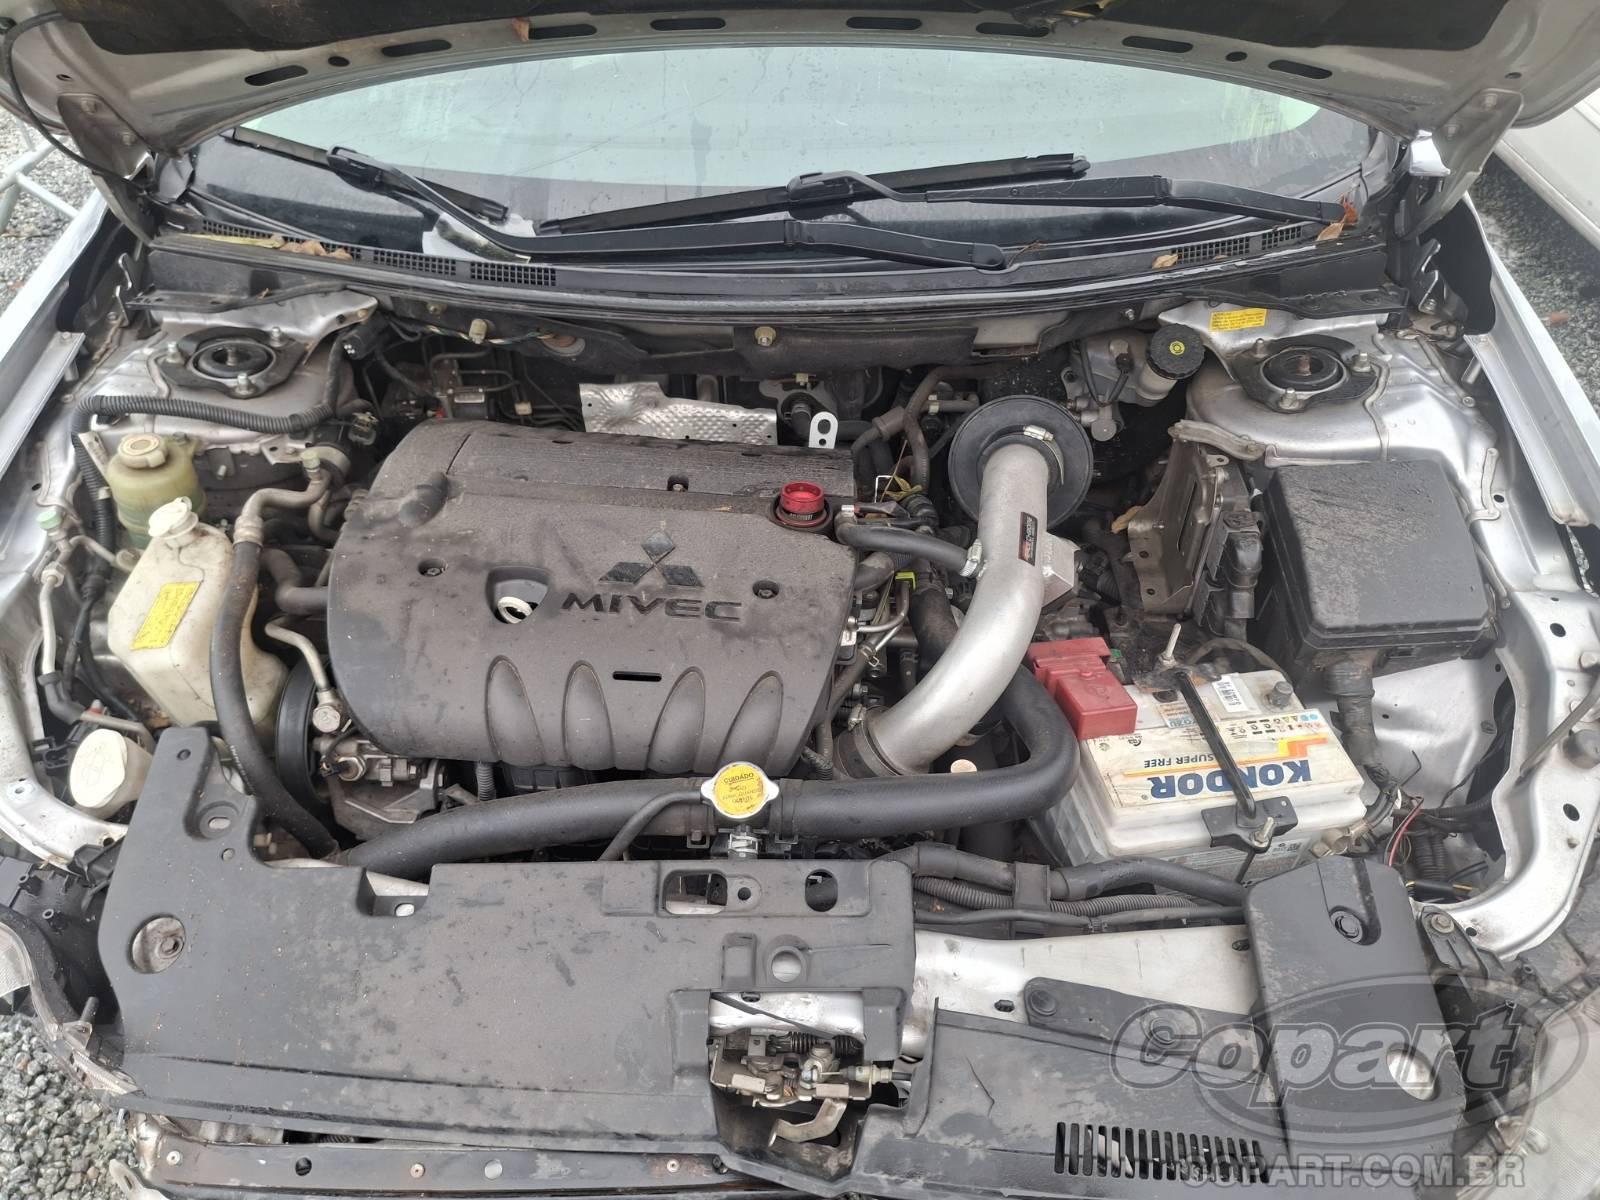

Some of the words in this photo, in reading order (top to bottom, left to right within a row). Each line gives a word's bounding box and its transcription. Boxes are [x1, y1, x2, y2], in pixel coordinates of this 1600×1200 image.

[561, 593, 742, 621] MIVEC
[1144, 757, 1171, 769] FREE
[1176, 753, 1215, 765] SUPER
